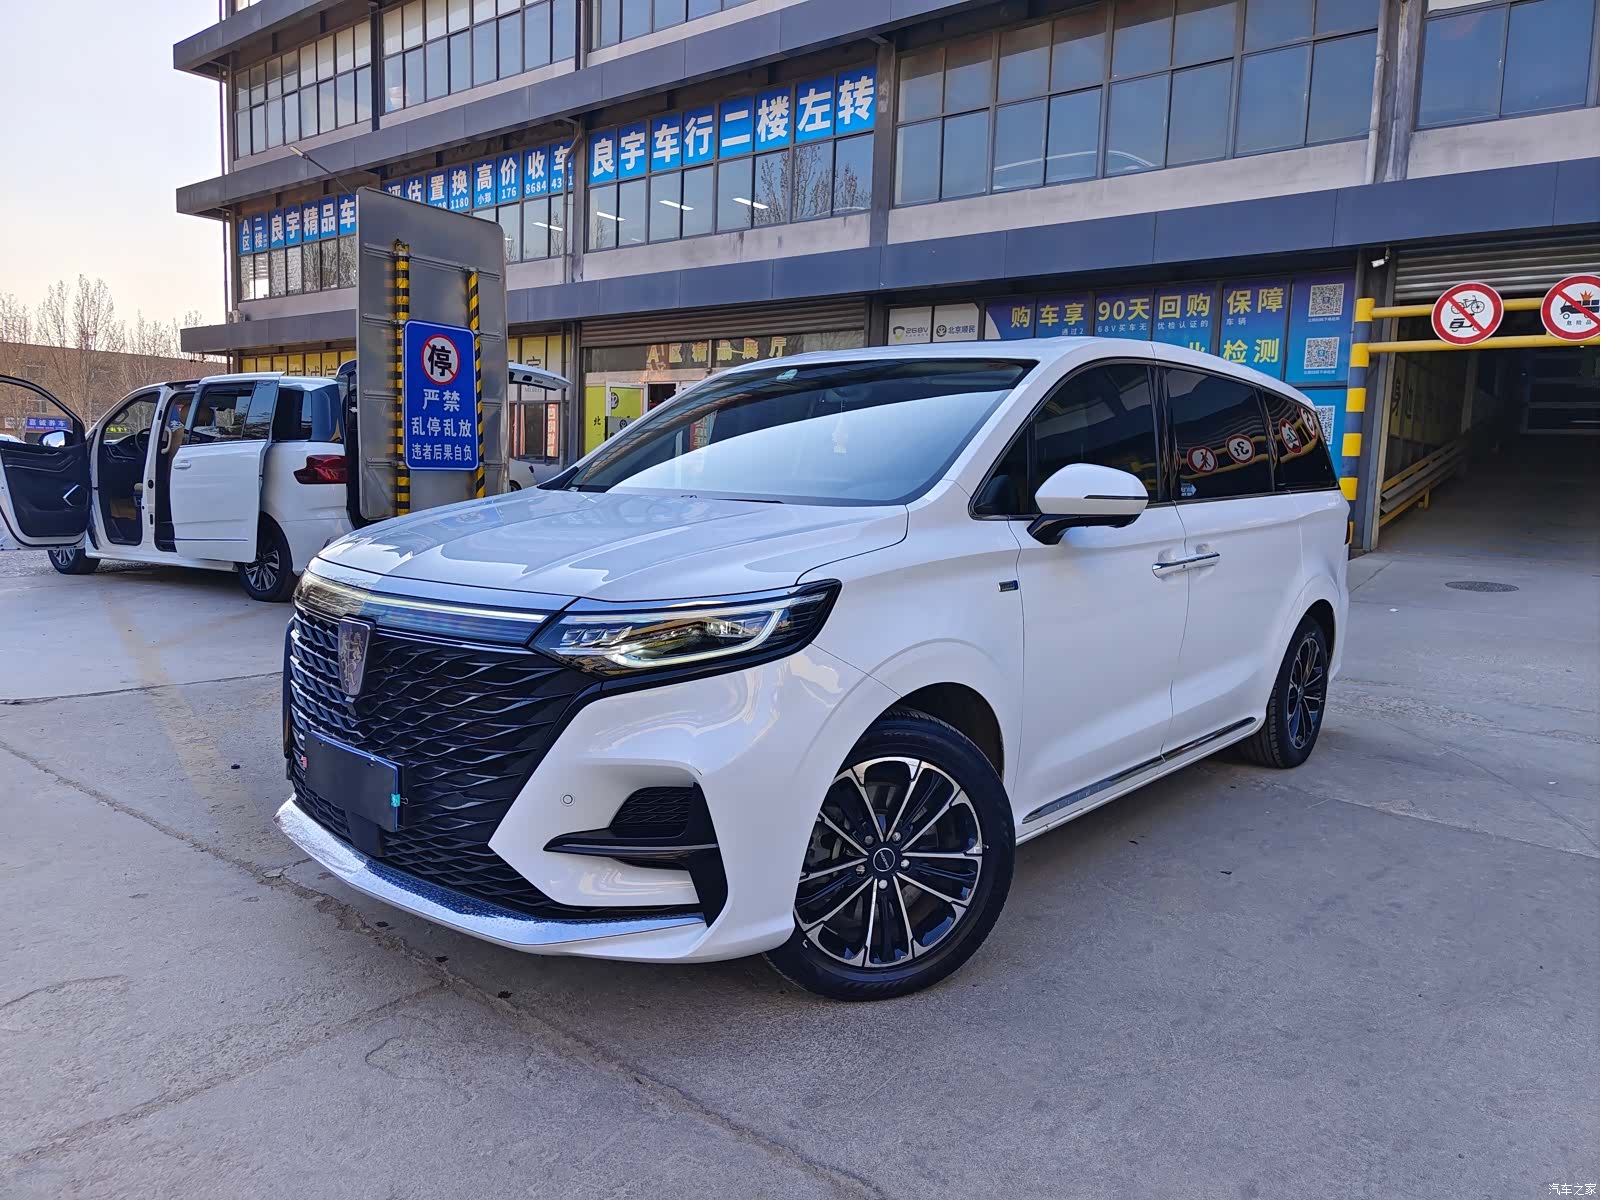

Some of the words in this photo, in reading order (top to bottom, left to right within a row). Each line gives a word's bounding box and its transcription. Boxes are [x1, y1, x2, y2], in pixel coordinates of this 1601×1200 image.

[592, 75, 874, 177] 良宇车行二楼左转
[450, 197, 470, 210] 1180
[501, 186, 517, 200] 176
[525, 179, 547, 195] 8684
[551, 175, 573, 189] 431
[427, 344, 453, 377] 停
[422, 388, 461, 413] 严禁
[411, 415, 472, 438] 乱停乱放
[411, 443, 473, 462] 违者后果自负
